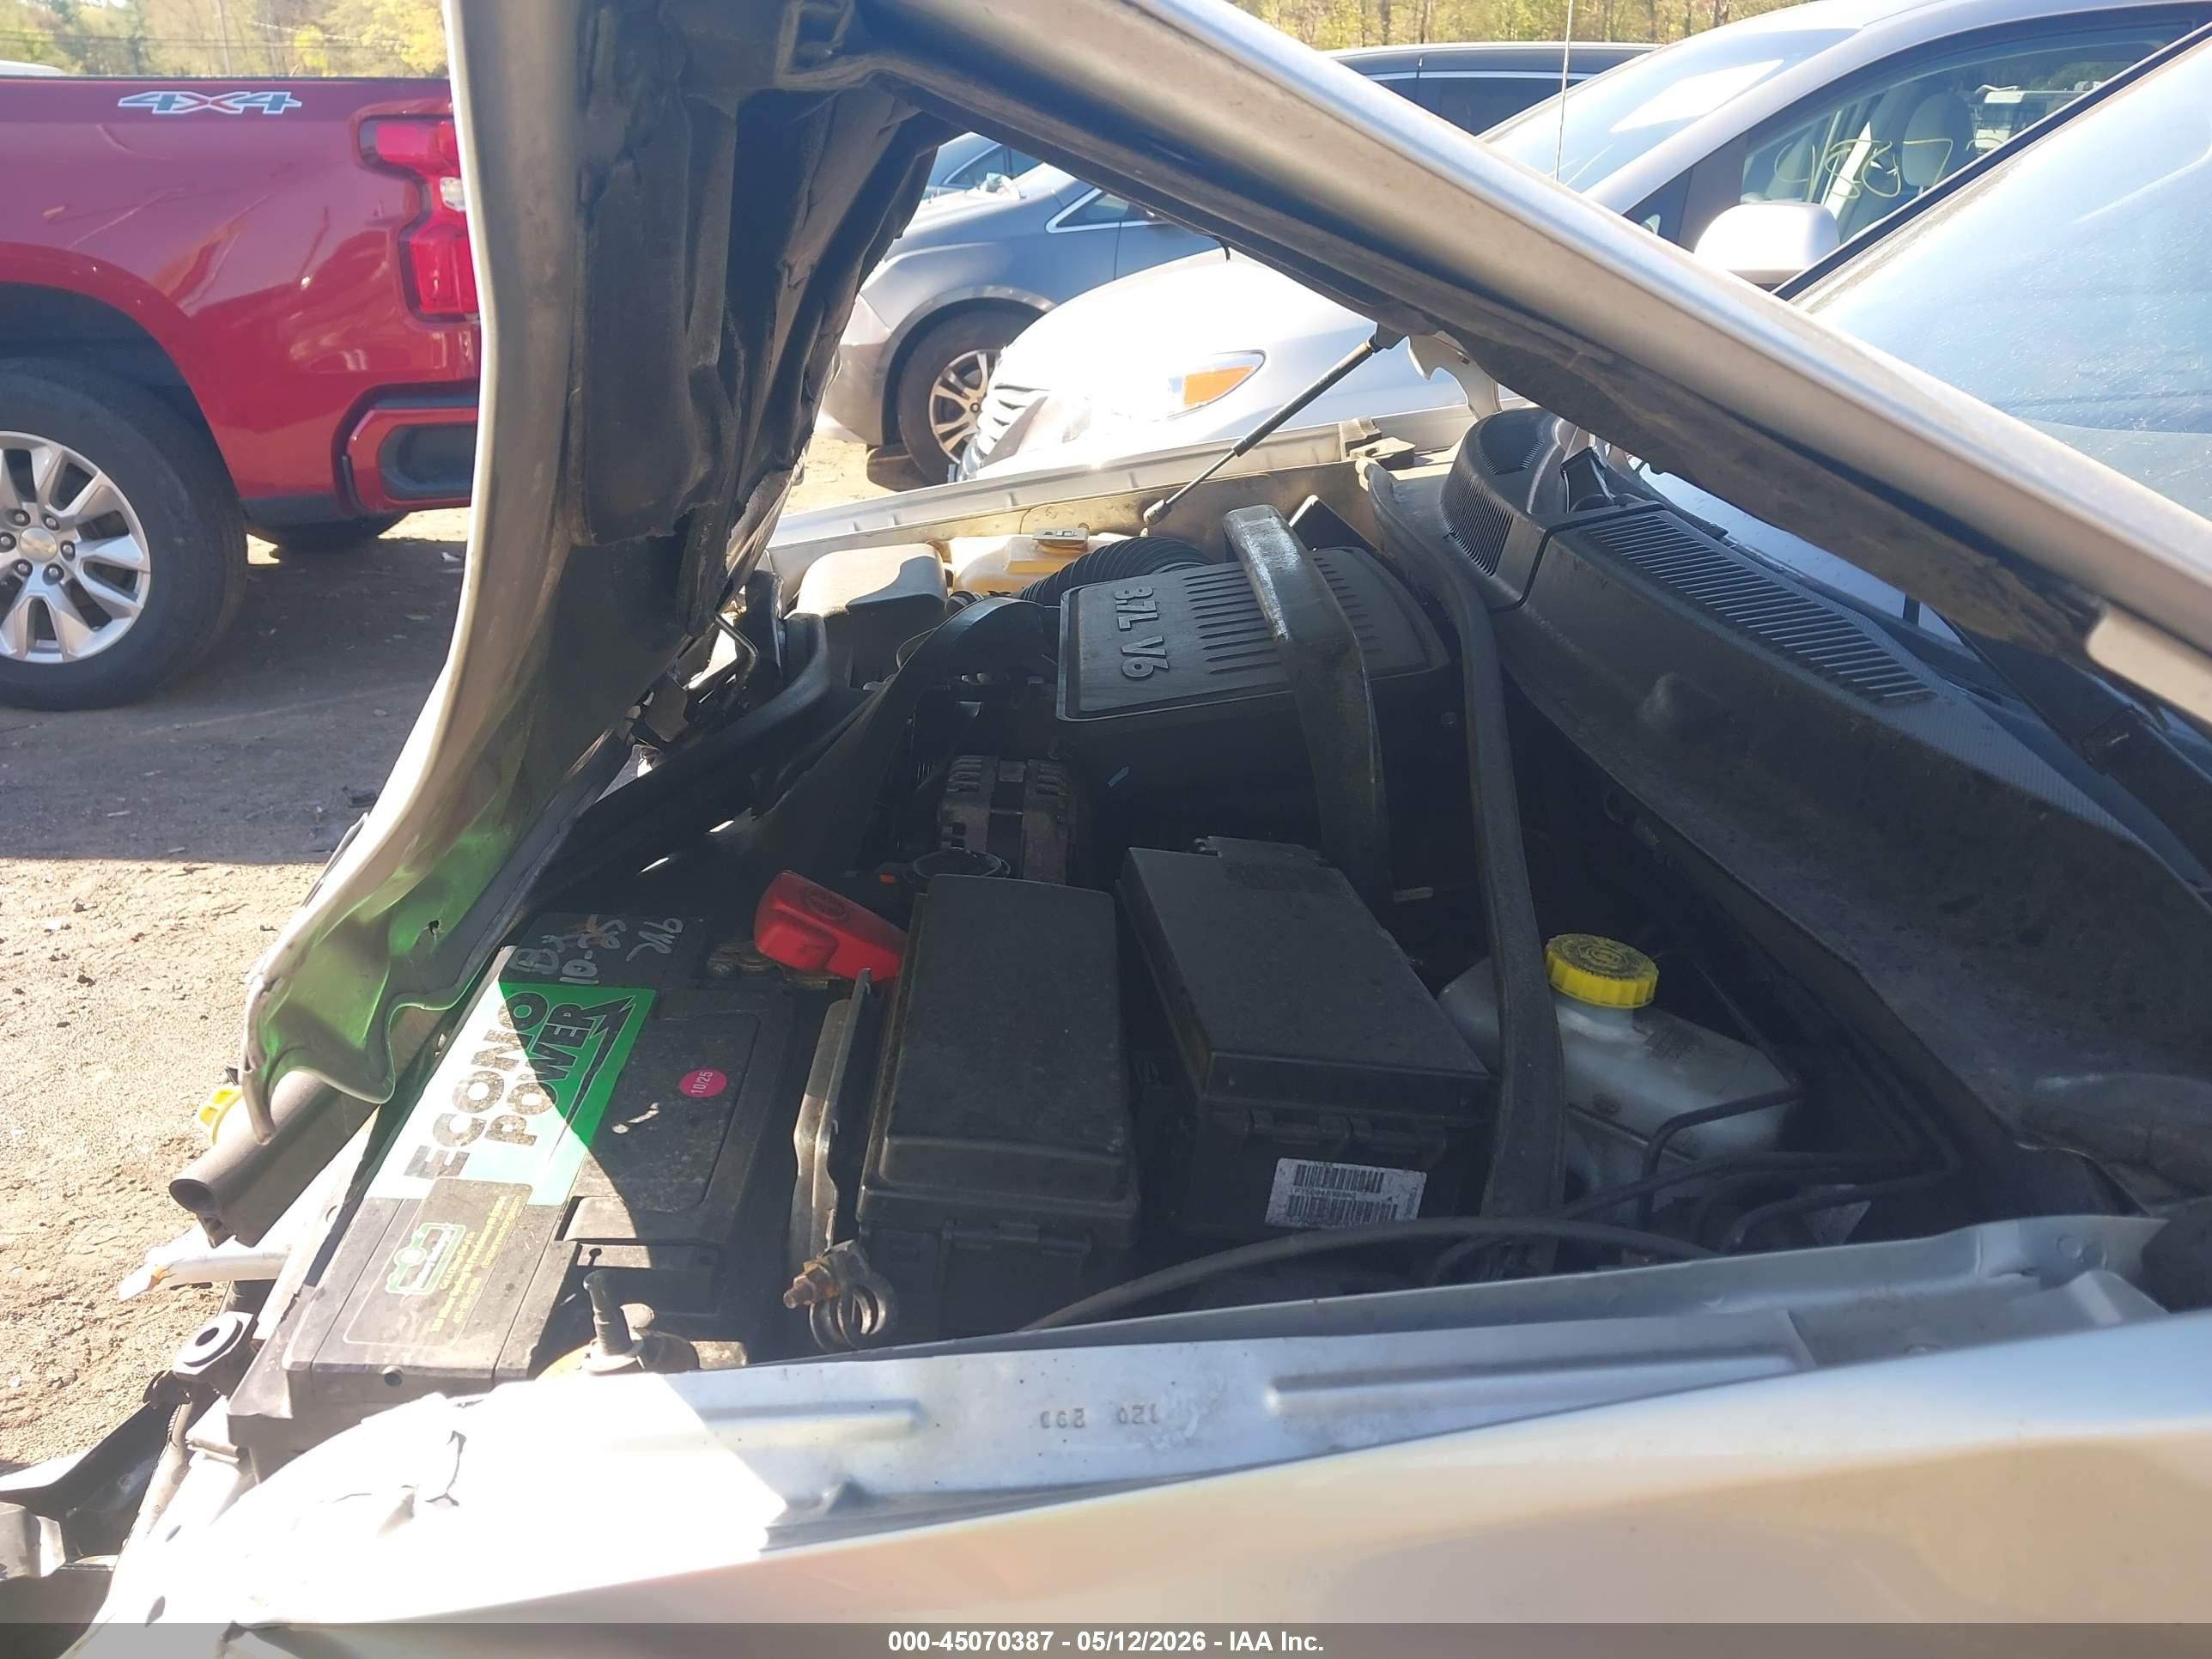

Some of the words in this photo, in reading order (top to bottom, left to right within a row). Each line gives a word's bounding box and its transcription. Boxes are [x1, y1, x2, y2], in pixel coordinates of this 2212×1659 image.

[1121, 635, 1169, 678] V6
[404, 991, 550, 1179] ECONO
[485, 1003, 598, 1146] POWER
[690, 1071, 714, 1094] 10/25
